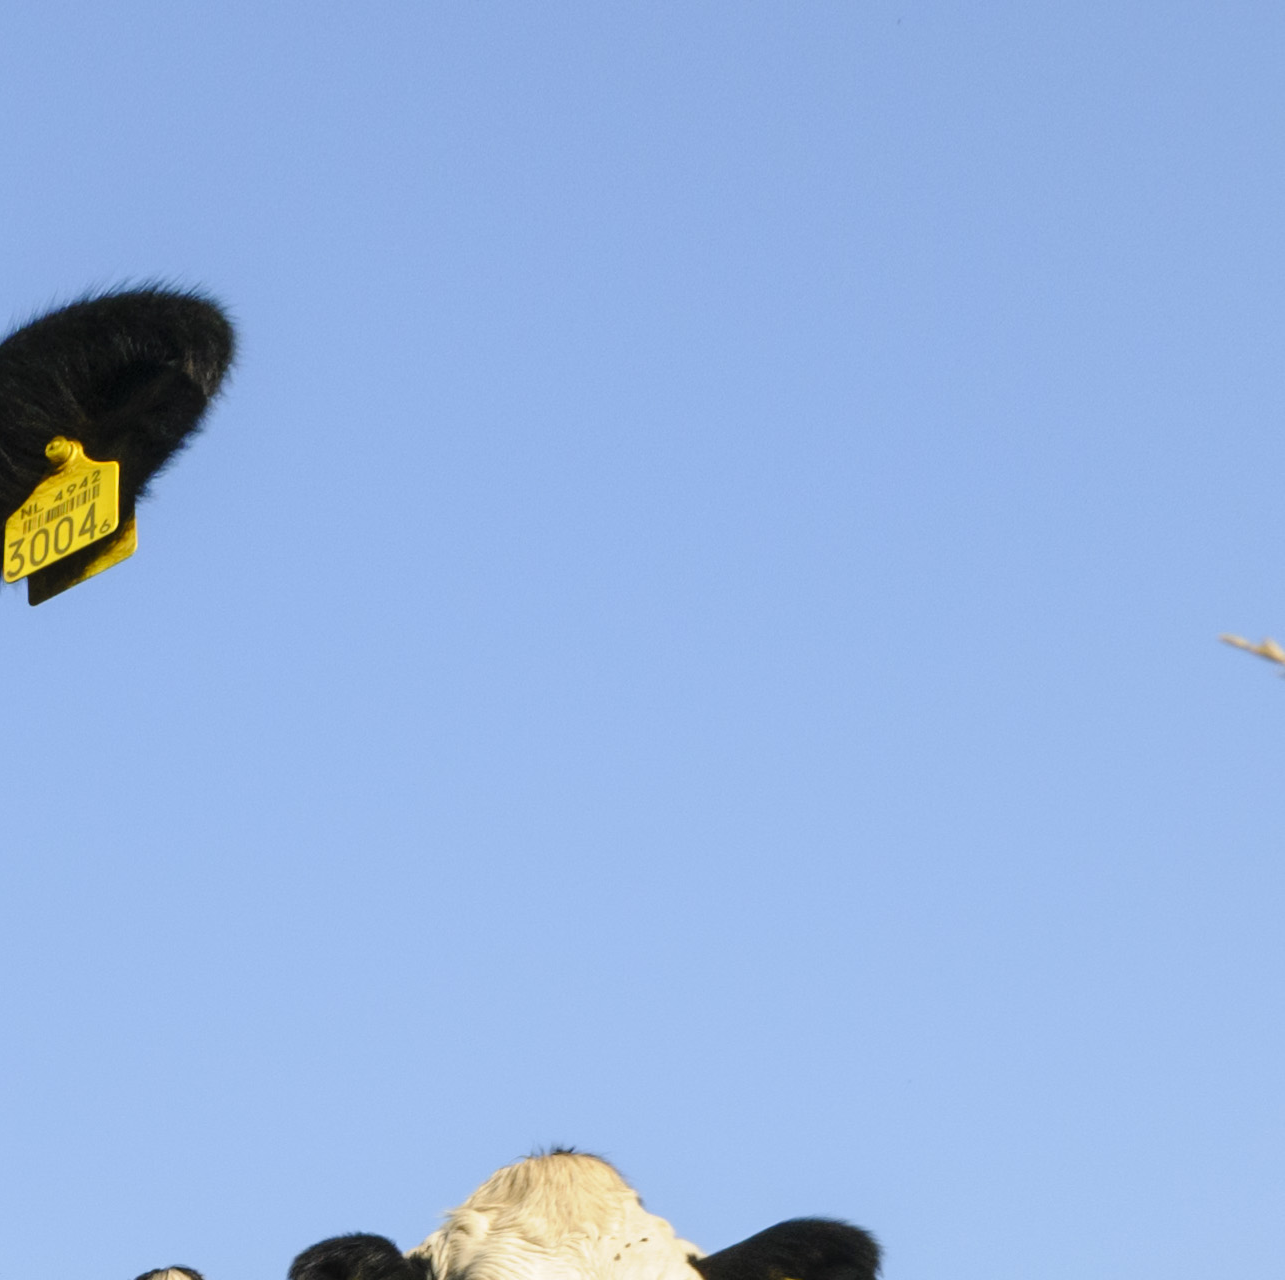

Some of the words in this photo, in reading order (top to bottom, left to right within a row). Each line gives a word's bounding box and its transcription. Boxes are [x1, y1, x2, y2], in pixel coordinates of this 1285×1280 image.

[19, 503, 43, 521] NL
[53, 468, 101, 502] 4942
[5, 502, 97, 578] 3004
